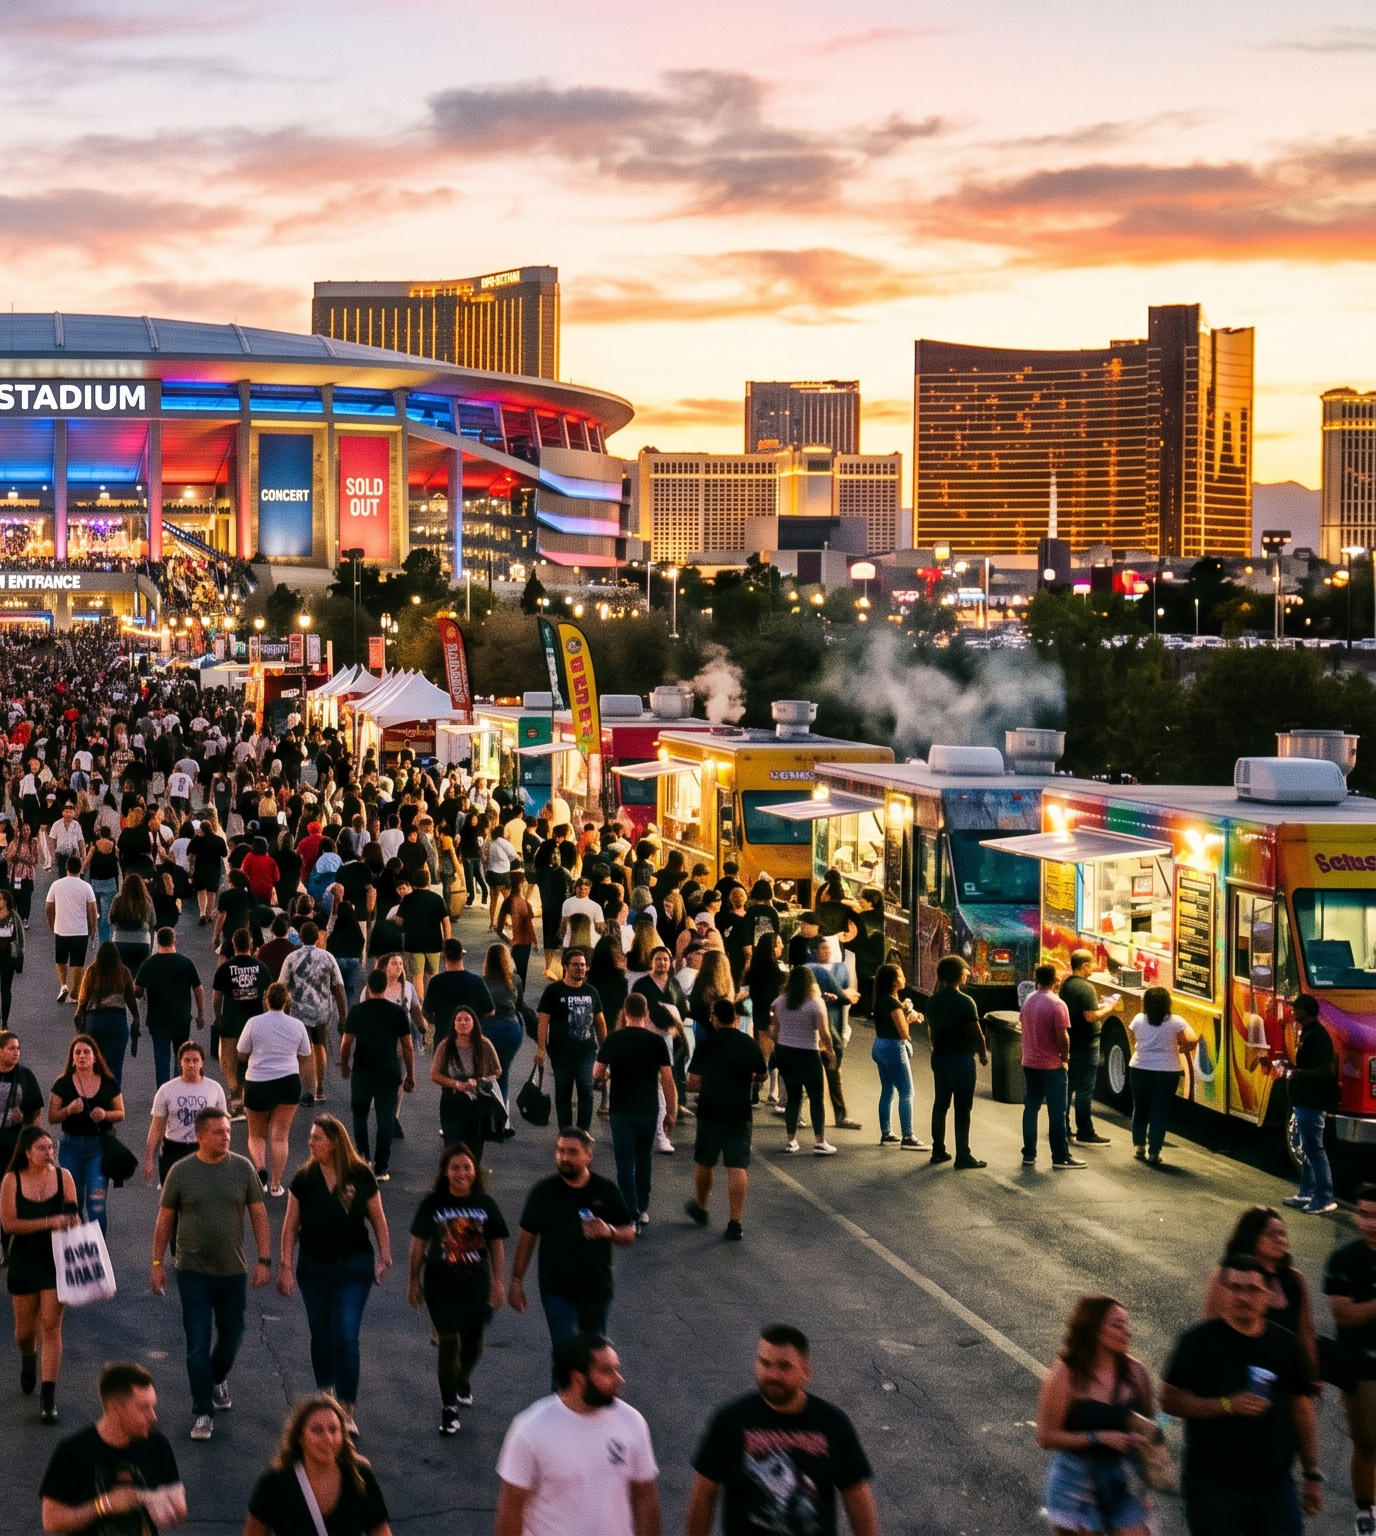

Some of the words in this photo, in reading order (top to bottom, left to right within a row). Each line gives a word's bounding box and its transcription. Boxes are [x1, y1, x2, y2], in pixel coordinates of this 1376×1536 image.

[345, 477, 383, 496] SOLD
[261, 488, 310, 502] CONCERT
[350, 498, 380, 516] OUT
[8, 574, 81, 589] ENTRANCE
